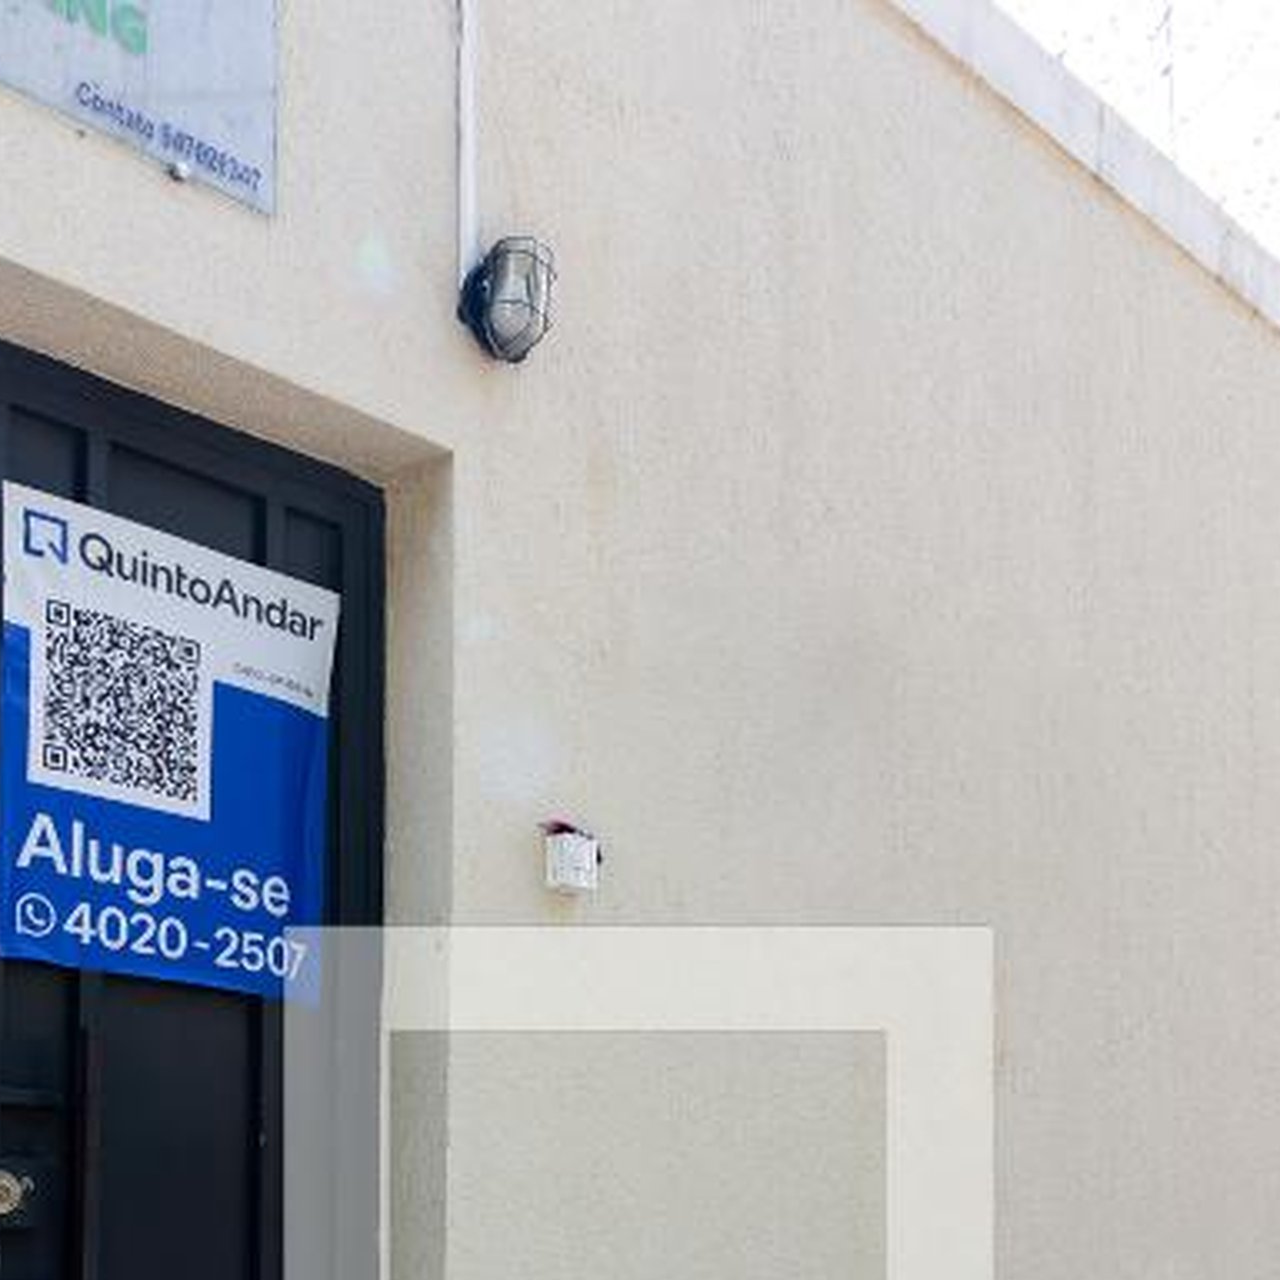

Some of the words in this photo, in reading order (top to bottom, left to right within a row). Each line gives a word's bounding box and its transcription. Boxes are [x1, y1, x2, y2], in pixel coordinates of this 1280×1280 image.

[75, 82, 154, 139] Contato
[79, 533, 323, 640] QuintoAndar
[16, 812, 291, 917] Aluga-se
[64, 902, 308, 979] 4020-2507
